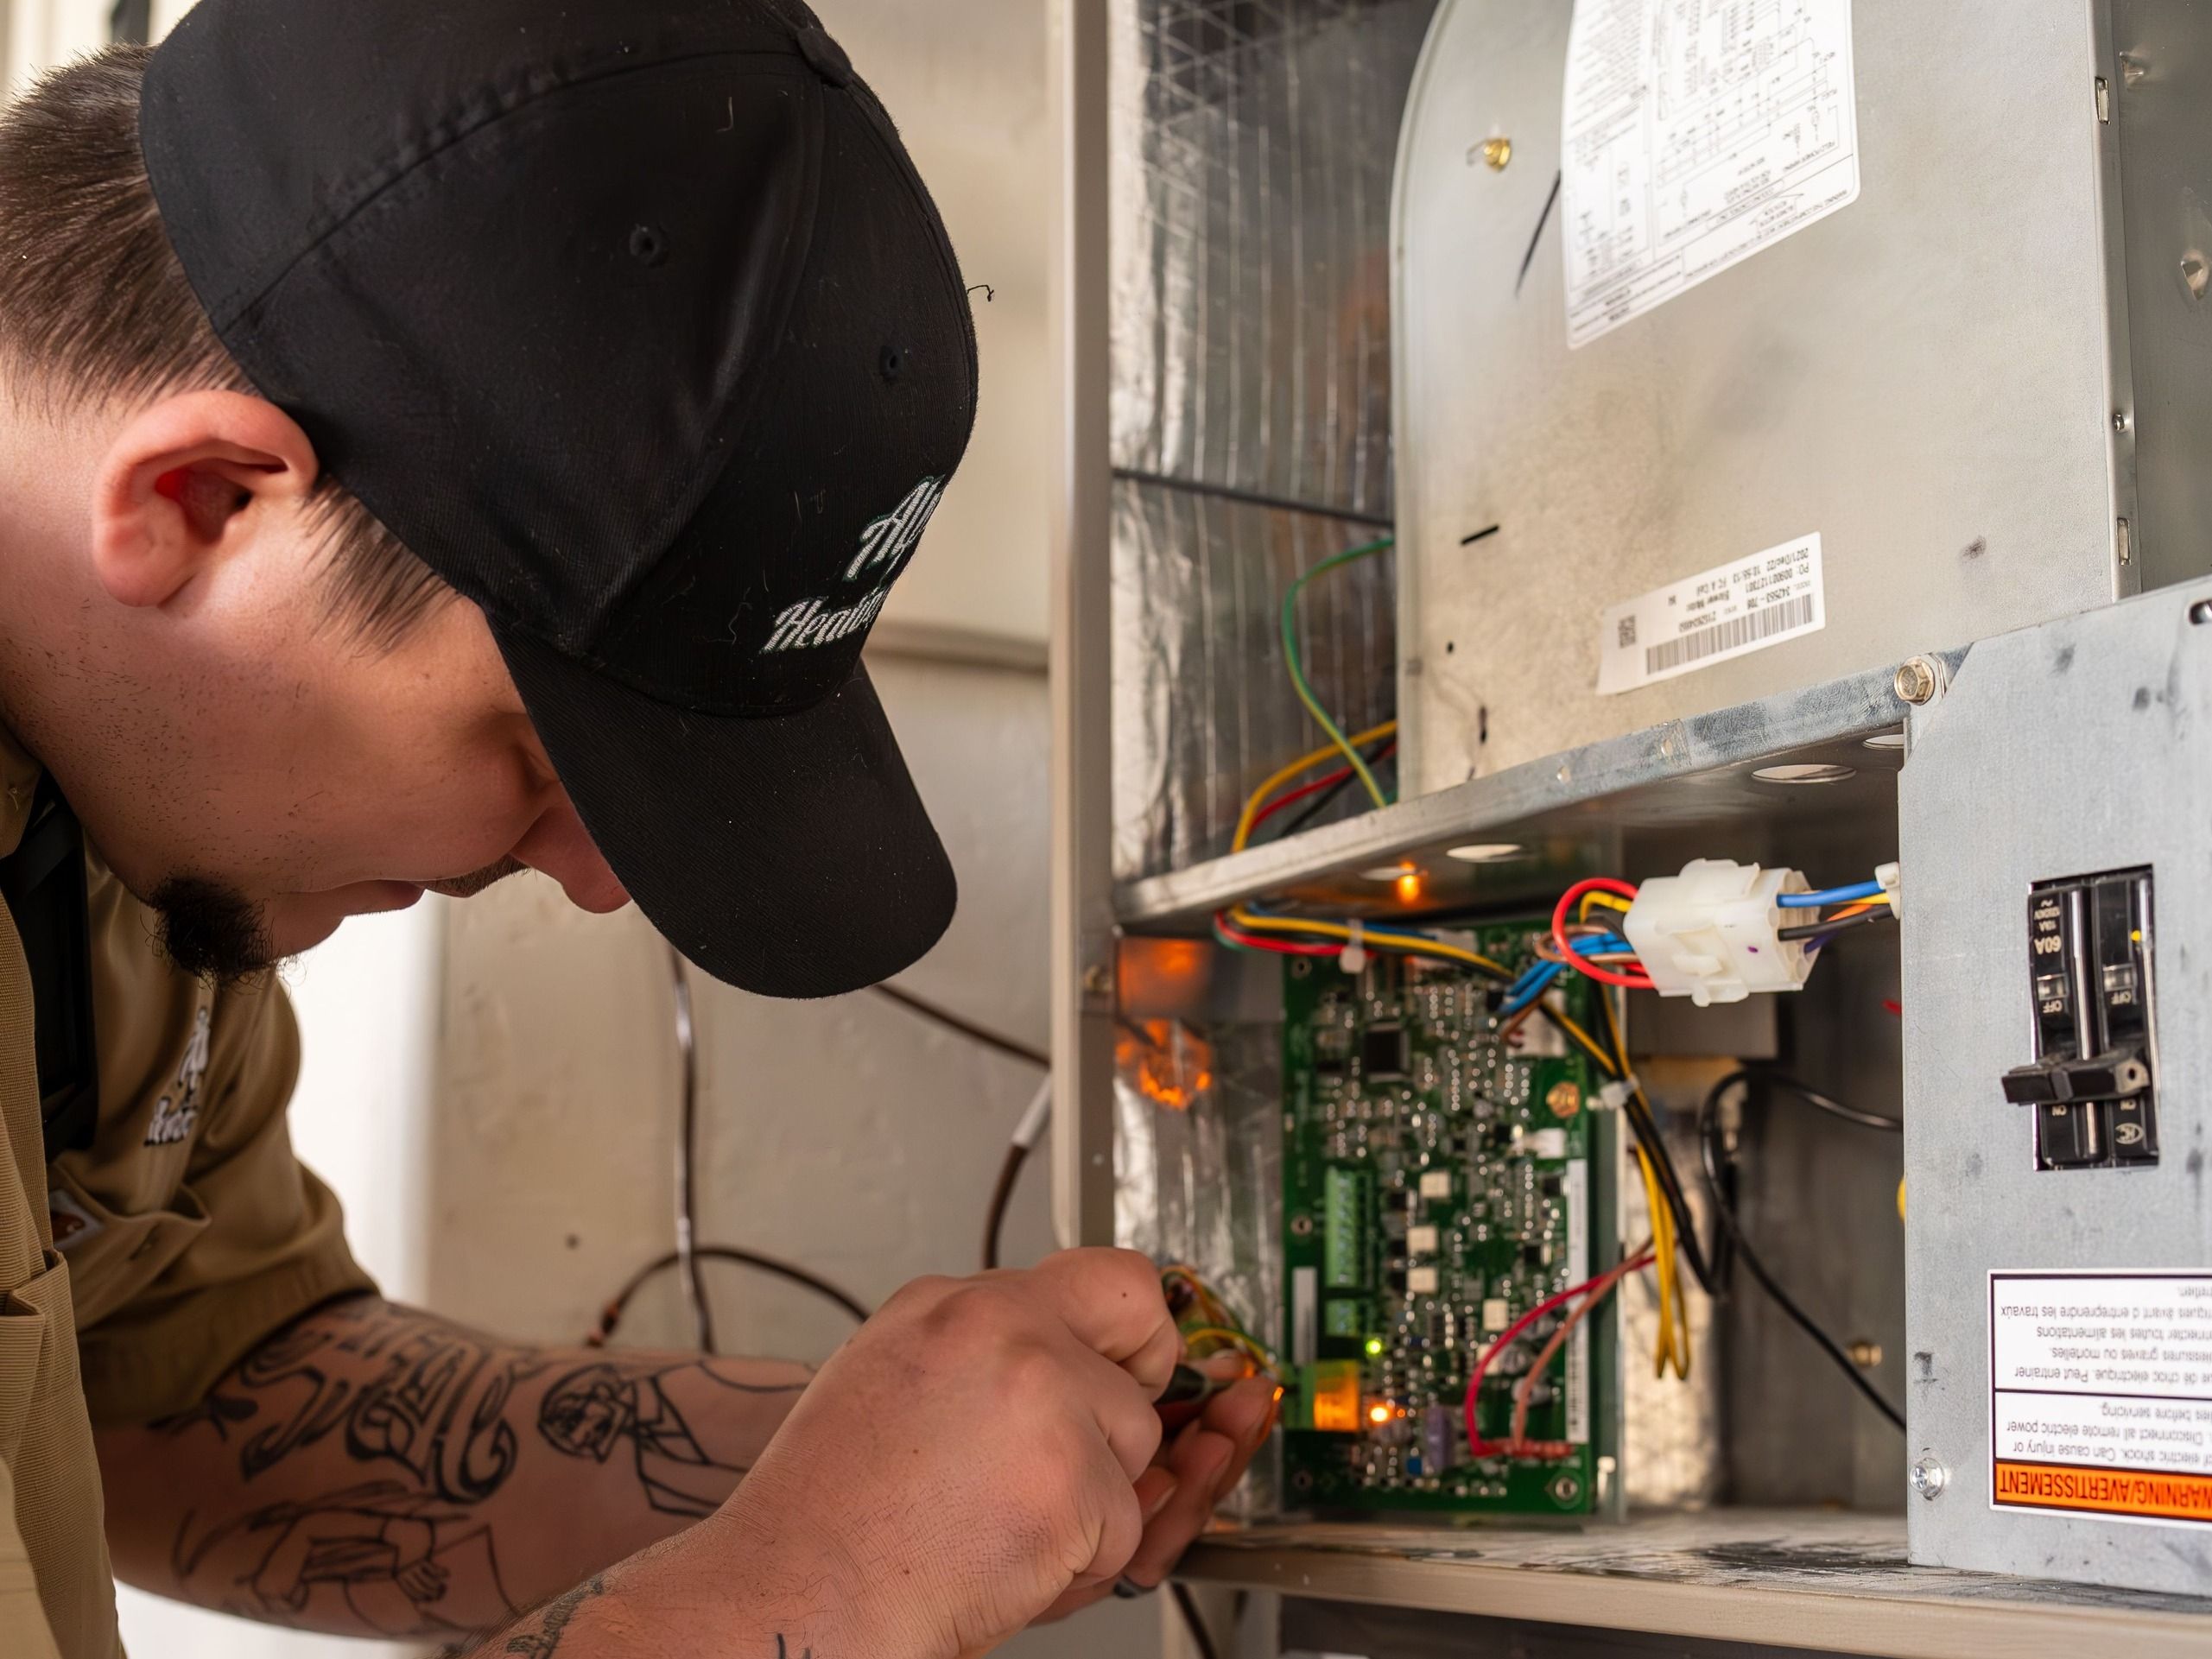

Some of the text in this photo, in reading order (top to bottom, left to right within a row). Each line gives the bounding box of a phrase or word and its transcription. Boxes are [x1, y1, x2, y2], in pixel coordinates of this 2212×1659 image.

[2033, 934, 2061, 955] 60A
[2111, 990, 2132, 1005] OFF
[2042, 1000, 2063, 1014] OFF
[2042, 1306, 2057, 1319] les
[2037, 1327, 2107, 1340] alimentations
[2104, 1349, 2118, 1359] ou
[2063, 1368, 2088, 1383] Peut
[2007, 1420, 2038, 1434] power
[2042, 1423, 2078, 1437] electric
[2082, 1427, 2120, 1437] remote
[2012, 1442, 2024, 1451] or
[2026, 1439, 2055, 1456] injury
[2058, 1444, 2090, 1455] cause
[2094, 1447, 2116, 1461] Can
